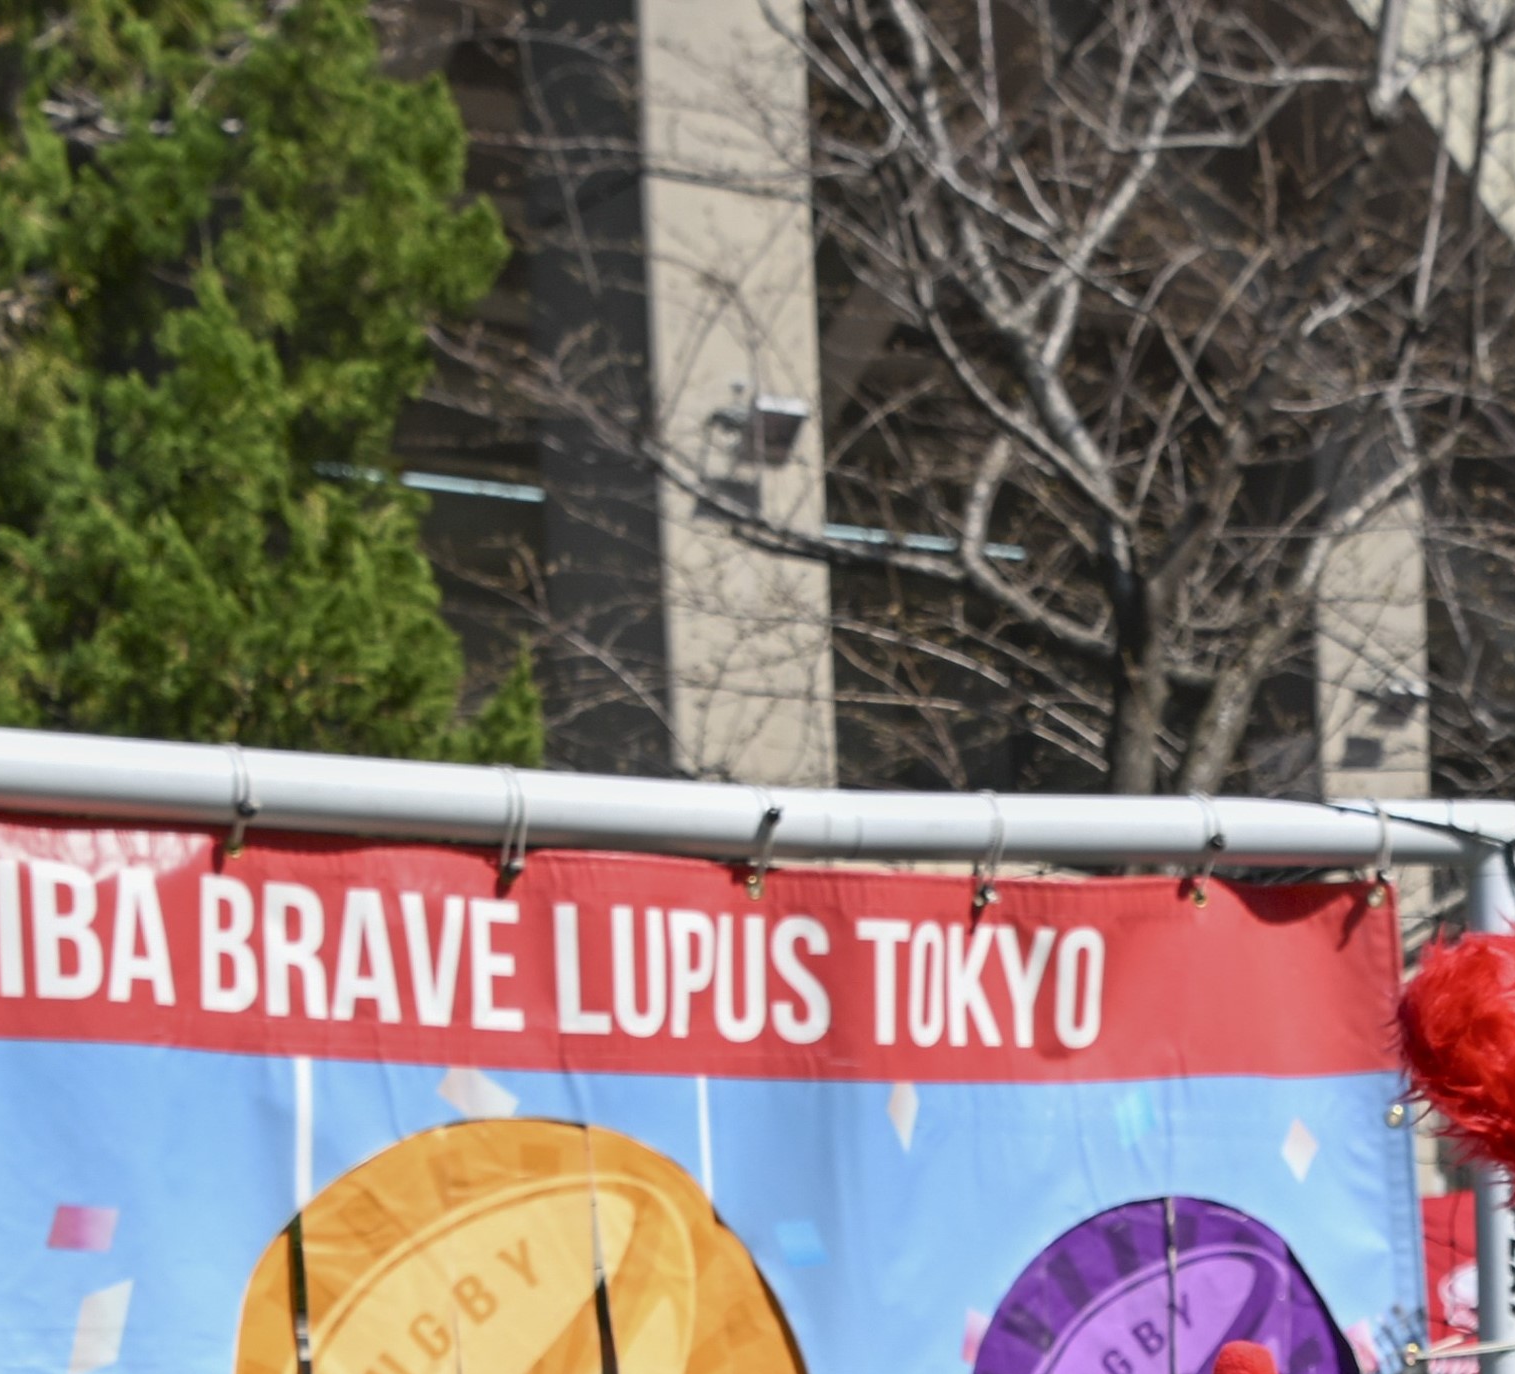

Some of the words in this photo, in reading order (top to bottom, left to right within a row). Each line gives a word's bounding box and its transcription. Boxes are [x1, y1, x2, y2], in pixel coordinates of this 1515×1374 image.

[198, 872, 525, 1033] BRAVE
[553, 900, 832, 1043] LUPUS
[856, 916, 1105, 1050] TOKYO
